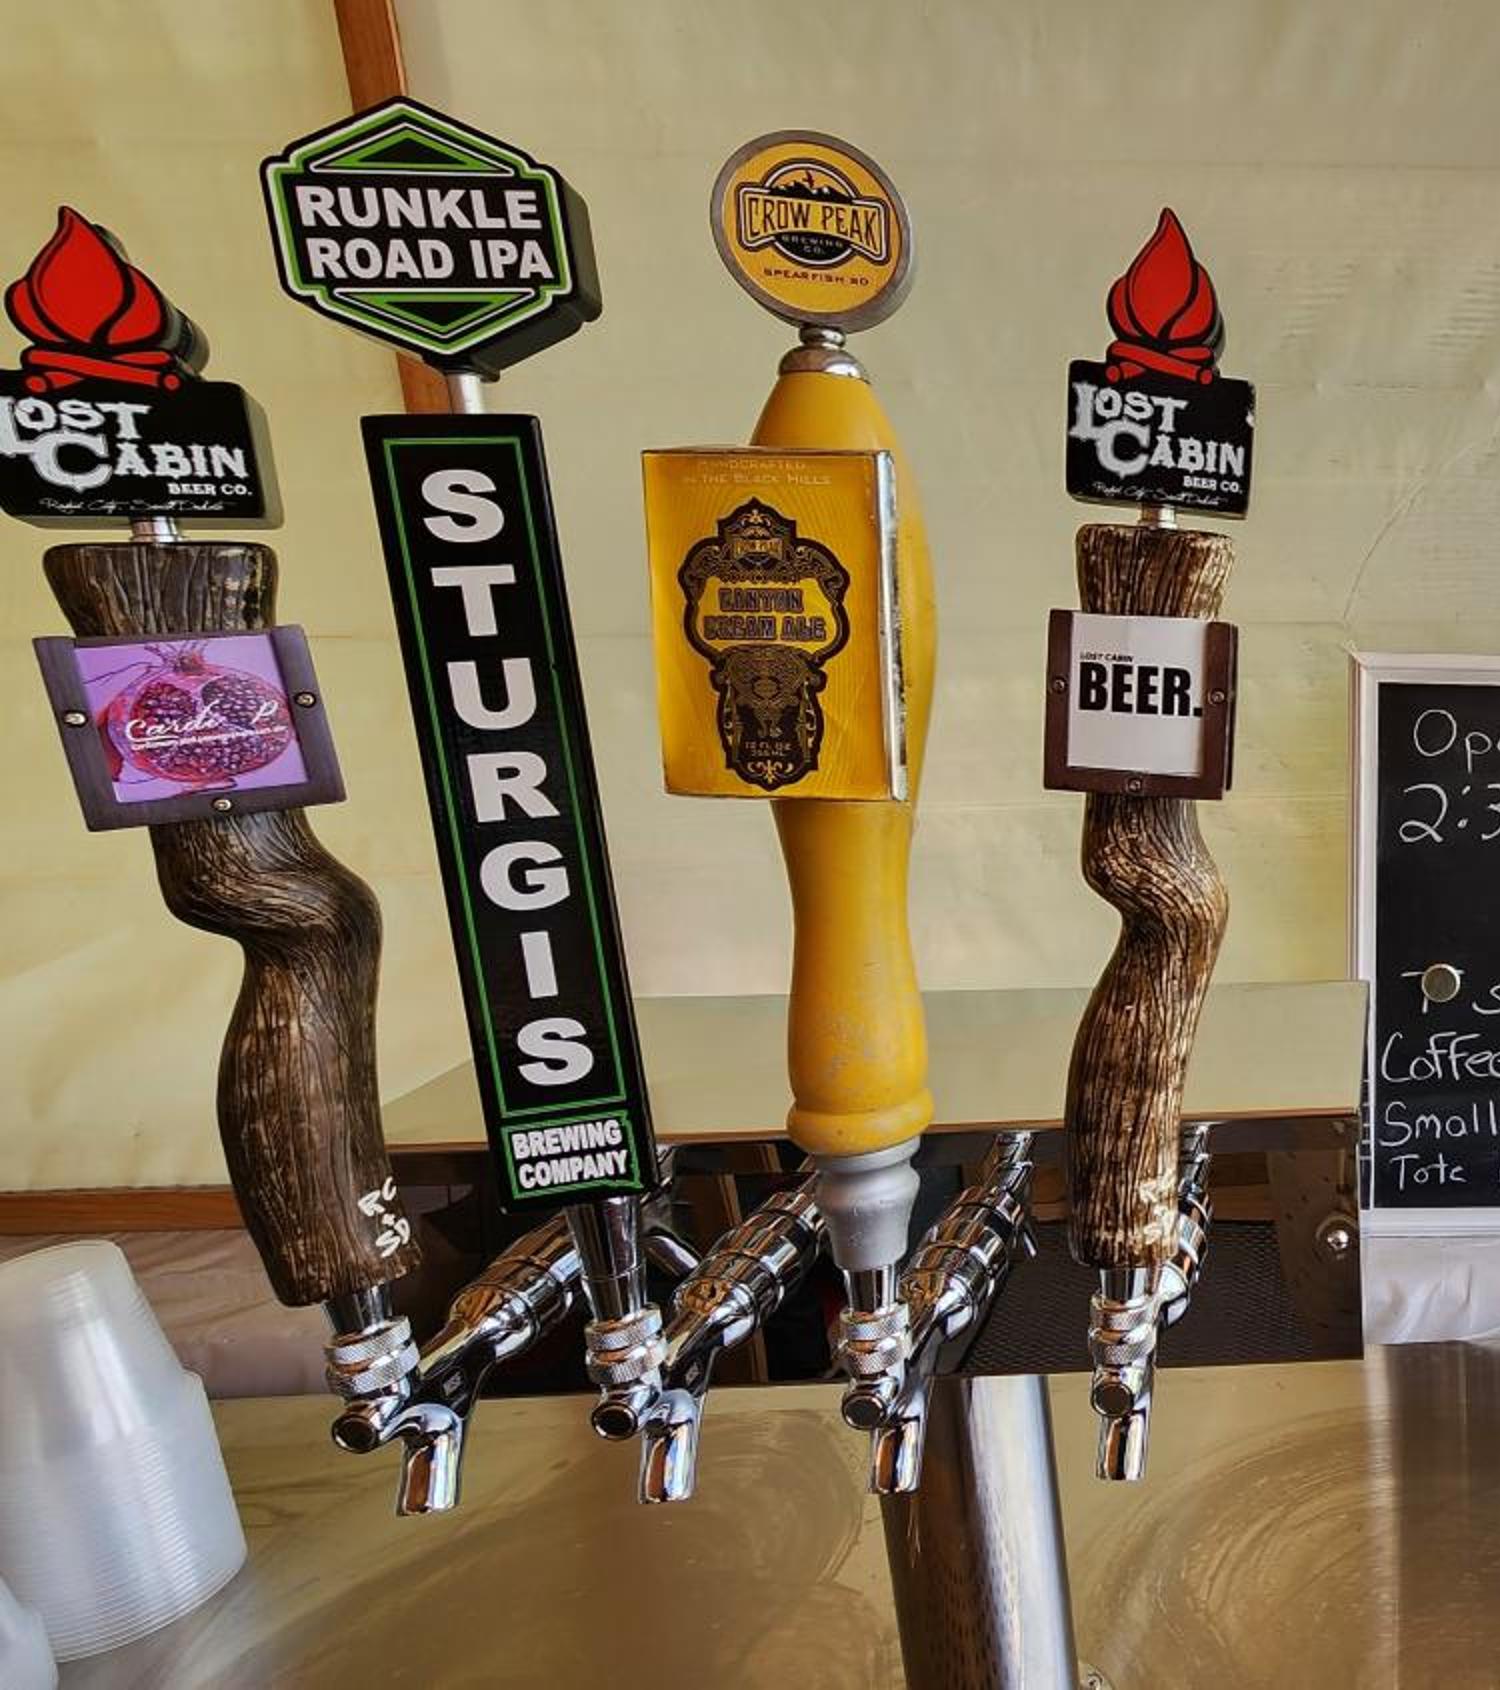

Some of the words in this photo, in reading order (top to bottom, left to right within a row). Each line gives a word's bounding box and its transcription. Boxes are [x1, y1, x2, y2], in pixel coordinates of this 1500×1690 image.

[295, 185, 543, 229] RUNKLE
[748, 197, 811, 237] CROW
[820, 205, 878, 251] PEAK
[305, 237, 455, 280] ROAD
[469, 239, 555, 280] IPA
[781, 233, 844, 248] BREWING
[1069, 380, 1189, 441] LOST
[28, 427, 249, 493] CABIN
[1095, 418, 1245, 479] CABIN
[167, 483, 217, 496] BEER
[220, 483, 252, 496] CO.
[787, 474, 832, 485] HILLS
[1183, 475, 1217, 491] BEER
[1219, 481, 1243, 494] CO.
[718, 587, 804, 613] CANYON
[703, 615, 777, 641] CREAM
[780, 616, 827, 642] ALE
[1079, 651, 1104, 661] LOST
[1105, 653, 1134, 663] CABIN
[1078, 661, 1203, 718] BEER.
[421, 468, 594, 1087] STURGIS
[510, 1119, 623, 1159] BREWING
[1379, 1100, 1498, 1147] Small
[517, 1150, 629, 1189] COMPANY
